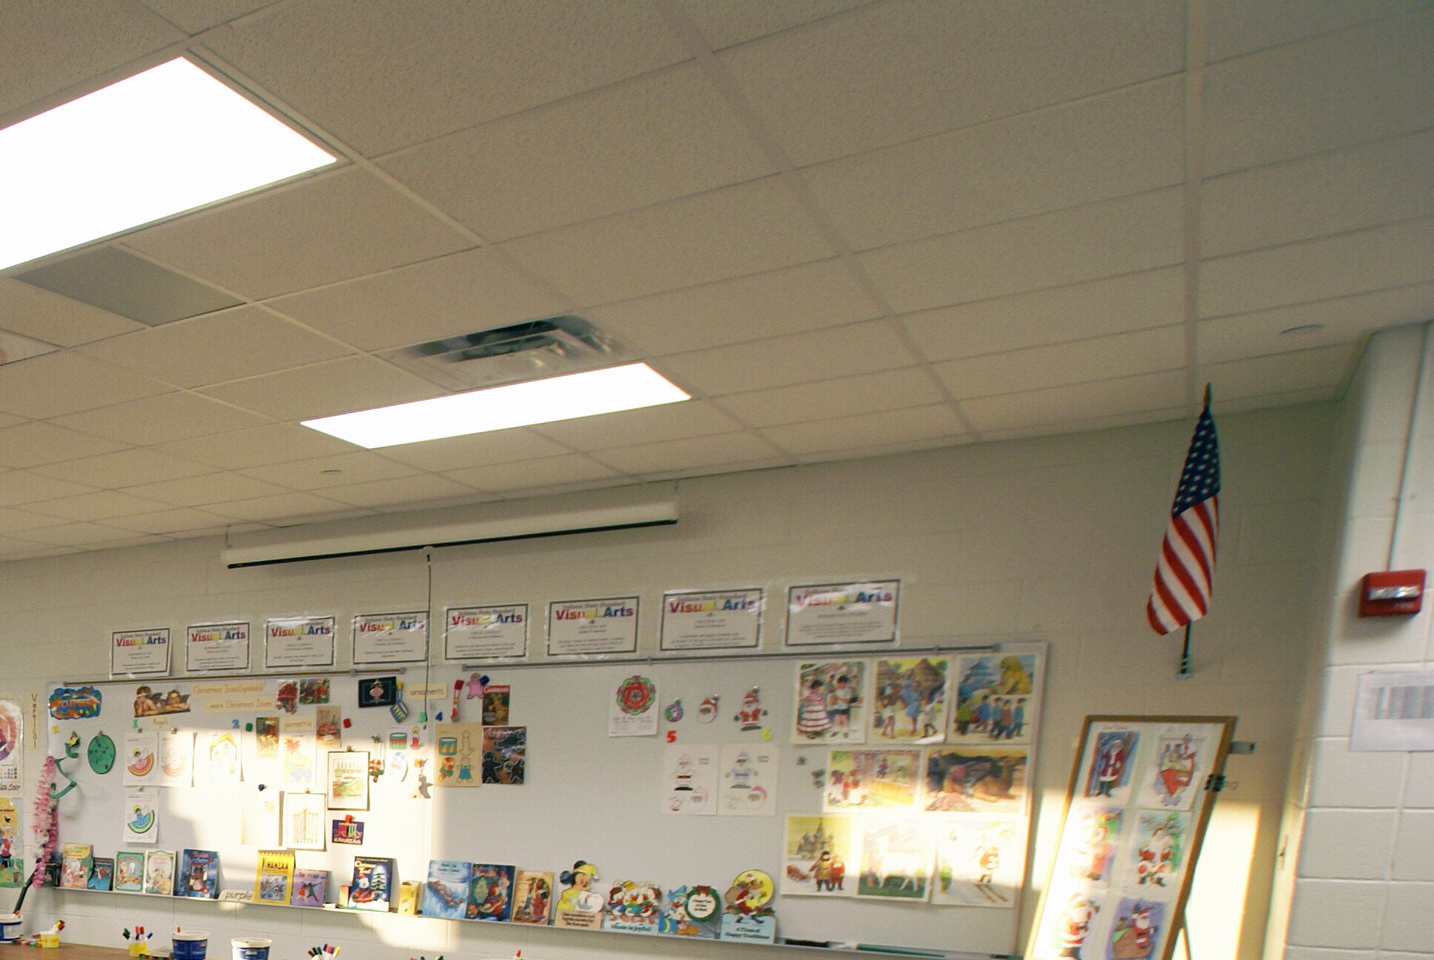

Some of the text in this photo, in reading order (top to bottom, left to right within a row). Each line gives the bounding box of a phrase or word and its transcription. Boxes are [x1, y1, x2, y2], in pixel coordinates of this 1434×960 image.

[855, 591, 893, 603] Arts
[669, 598, 756, 613] Visual Arts
[496, 613, 523, 624] Arts
[554, 606, 633, 621] Visual Arts
[191, 630, 246, 642] Visual Arts
[271, 625, 331, 637] Visual Arts
[116, 636, 166, 647] Visual Arts
[666, 730, 677, 743] 5
[225, 890, 254, 902] purple
